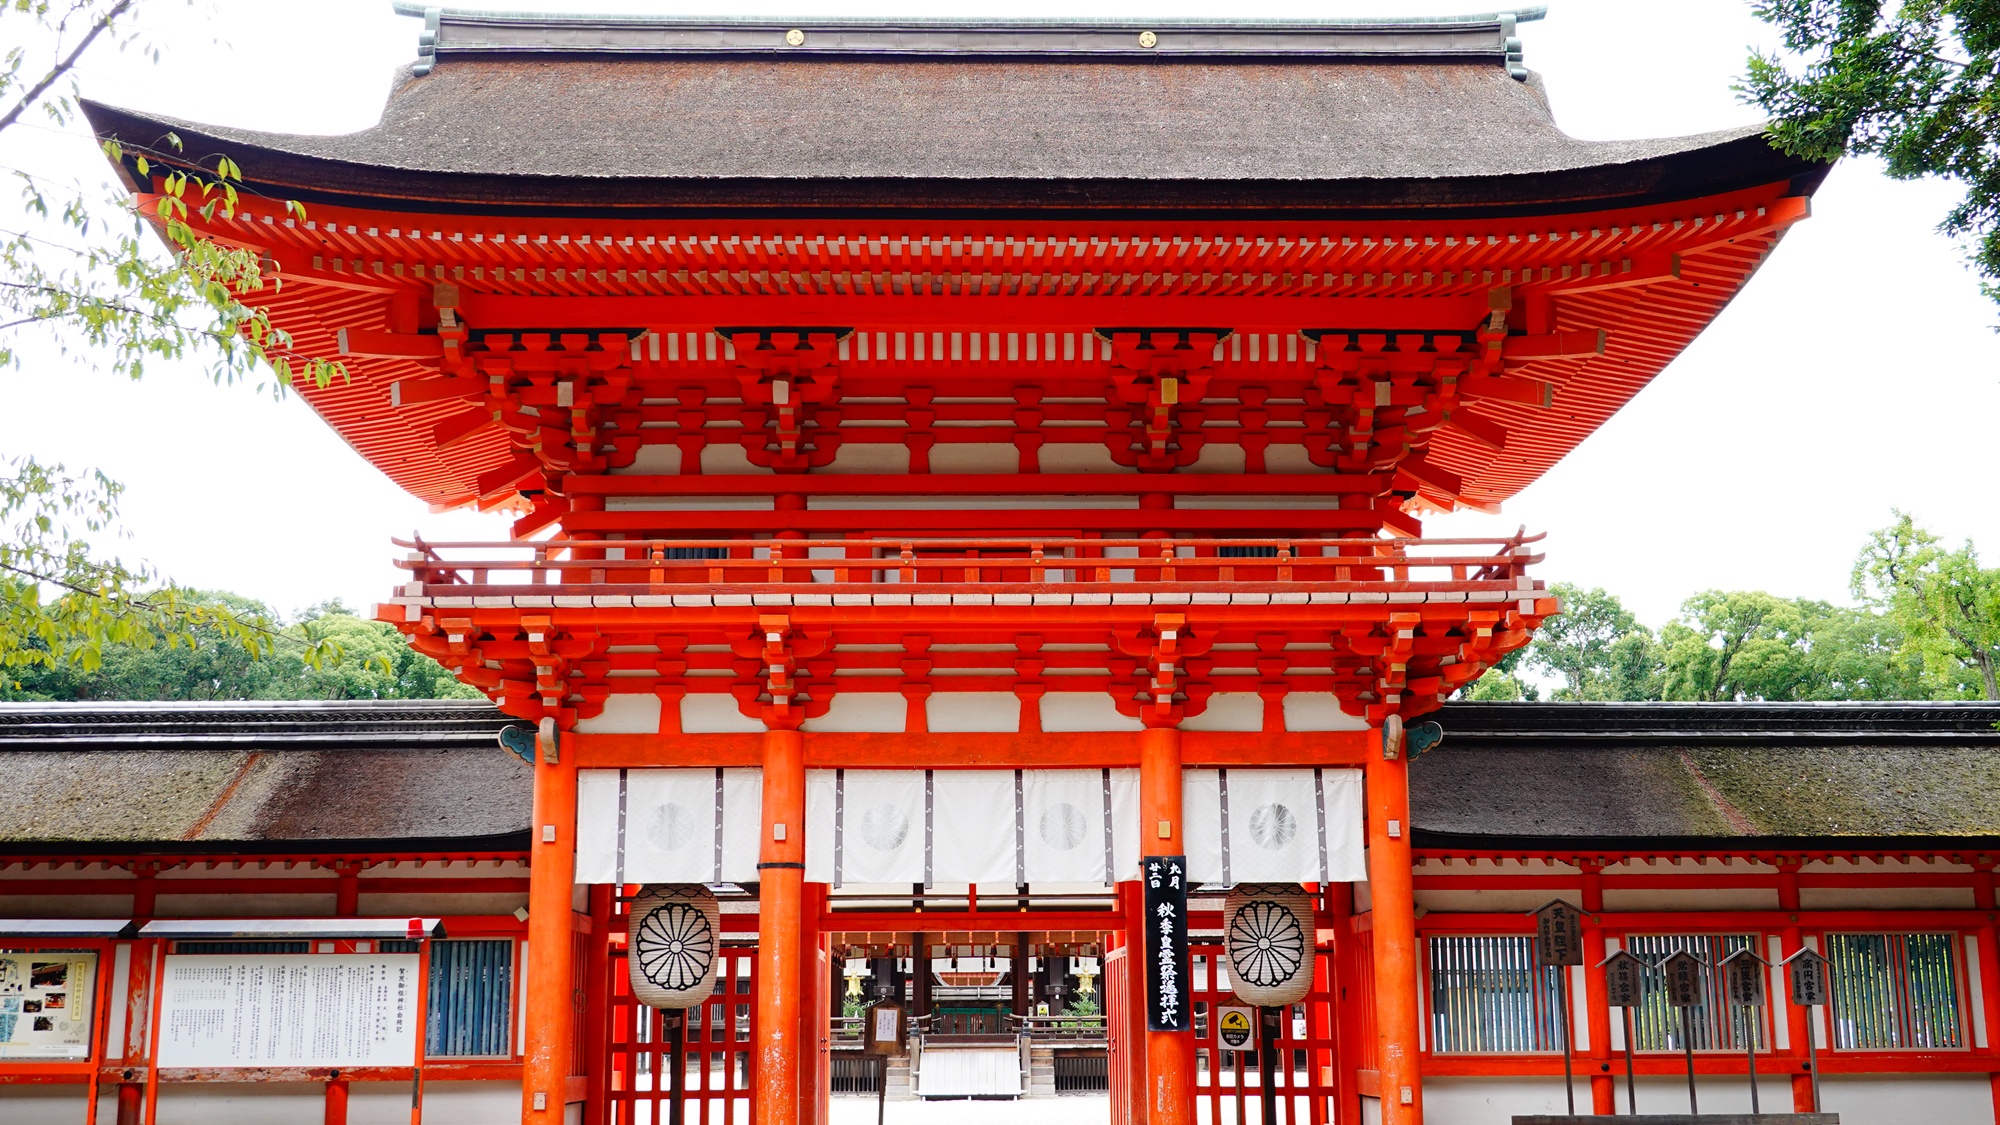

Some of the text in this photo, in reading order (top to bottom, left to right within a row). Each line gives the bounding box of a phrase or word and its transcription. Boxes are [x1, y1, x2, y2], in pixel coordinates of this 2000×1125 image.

[1168, 863, 1182, 890] 九月
[1552, 907, 1568, 960] 天皇陛下
[1617, 960, 1631, 1003] 秋篠宮家
[1802, 958, 1816, 1001] 高円宮家
